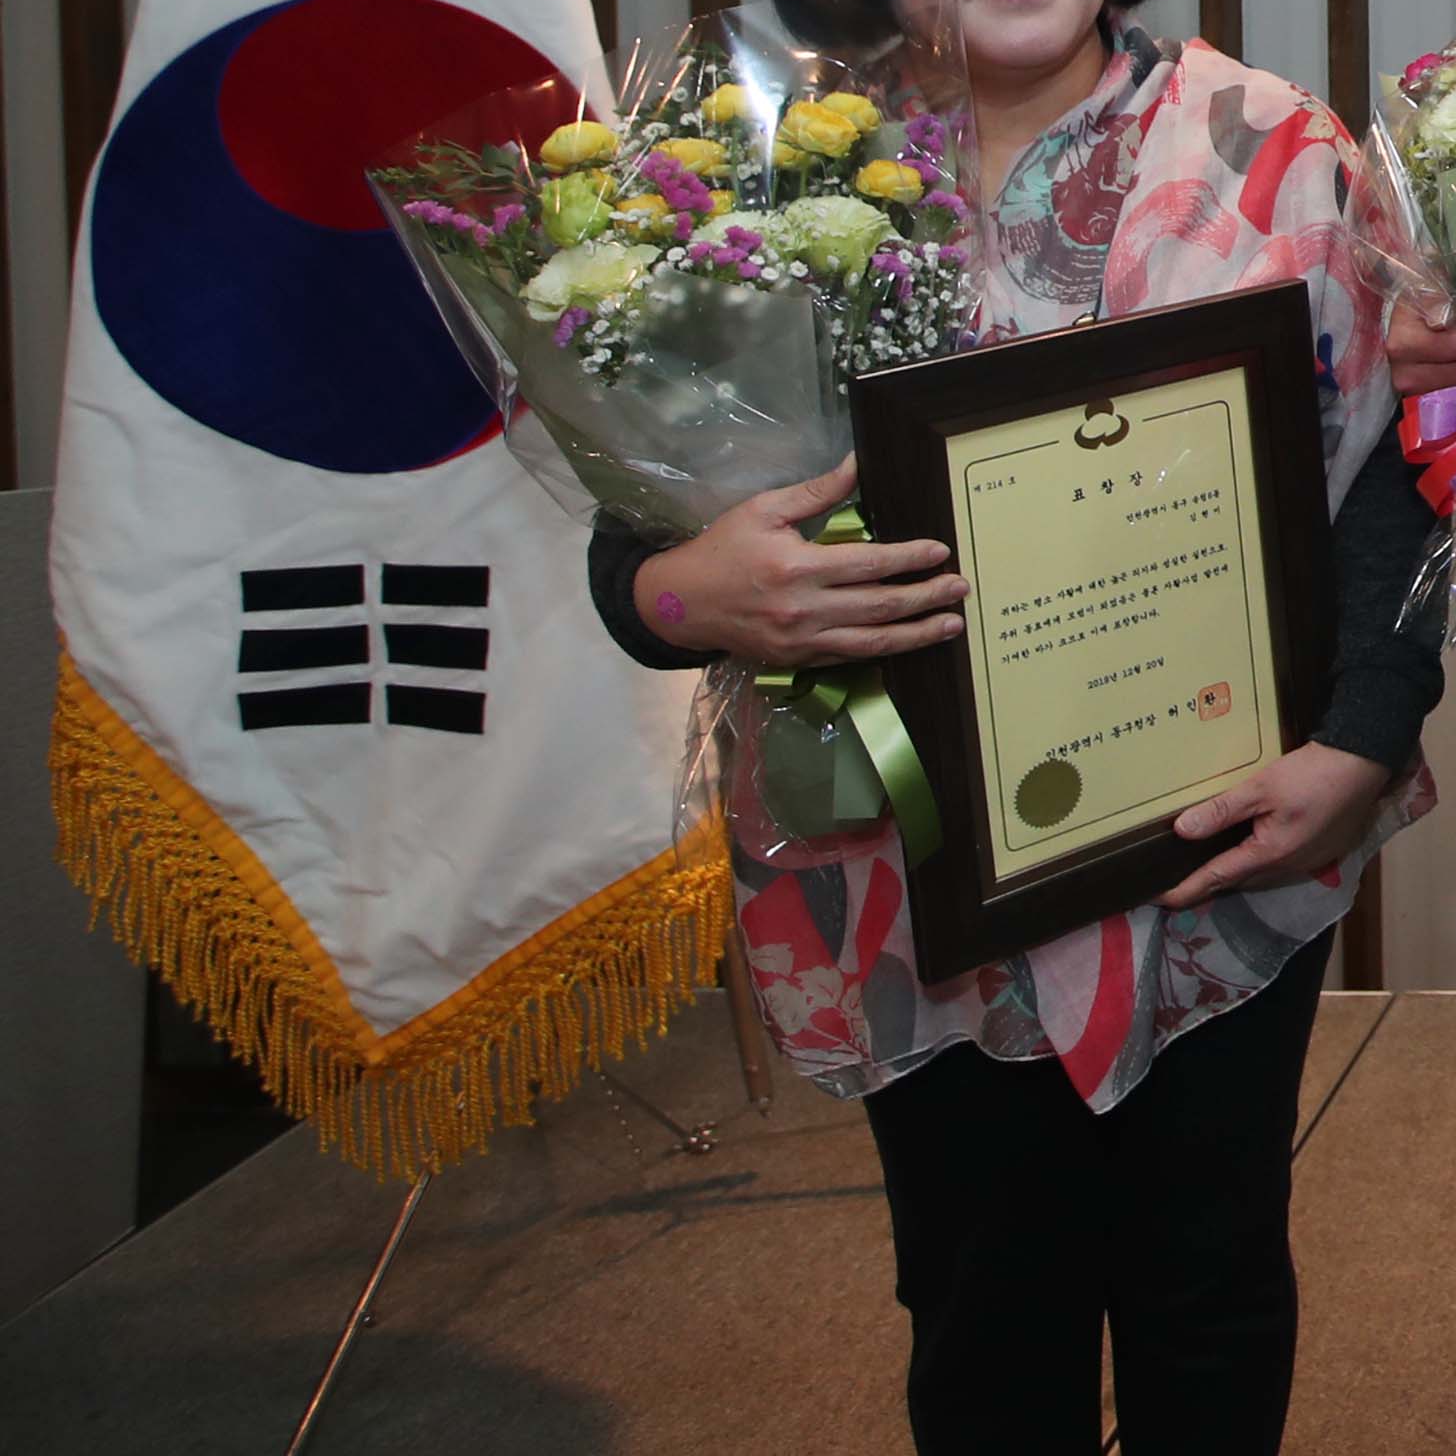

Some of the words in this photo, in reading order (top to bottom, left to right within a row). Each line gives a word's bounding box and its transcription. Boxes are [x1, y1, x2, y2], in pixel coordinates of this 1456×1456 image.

[1072, 487, 1086, 503] 표
[1100, 479, 1114, 495] 창
[1129, 471, 1143, 487] 장
